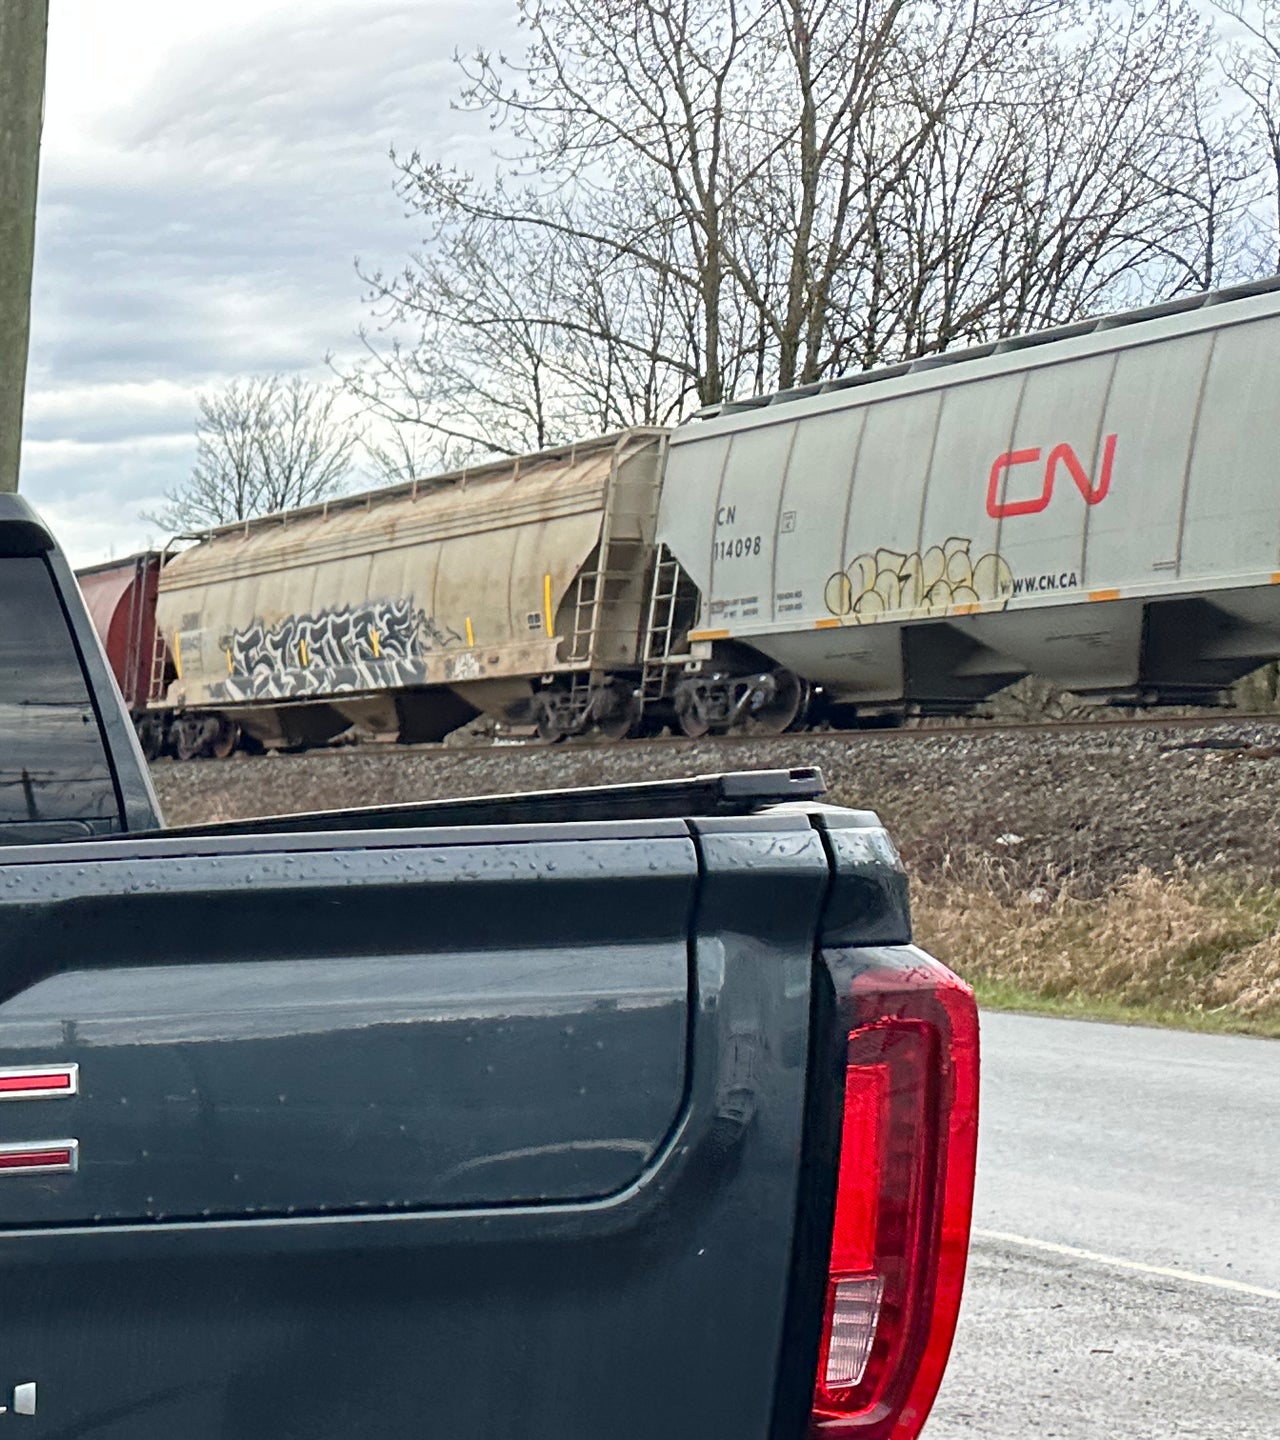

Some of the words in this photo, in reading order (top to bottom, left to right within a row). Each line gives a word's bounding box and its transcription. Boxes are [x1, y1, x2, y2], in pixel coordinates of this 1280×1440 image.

[986, 434, 1118, 519] CN
[716, 505, 736, 526] CN
[714, 535, 761, 560] 114098
[1000, 572, 1078, 595] WWW.CN.CA
